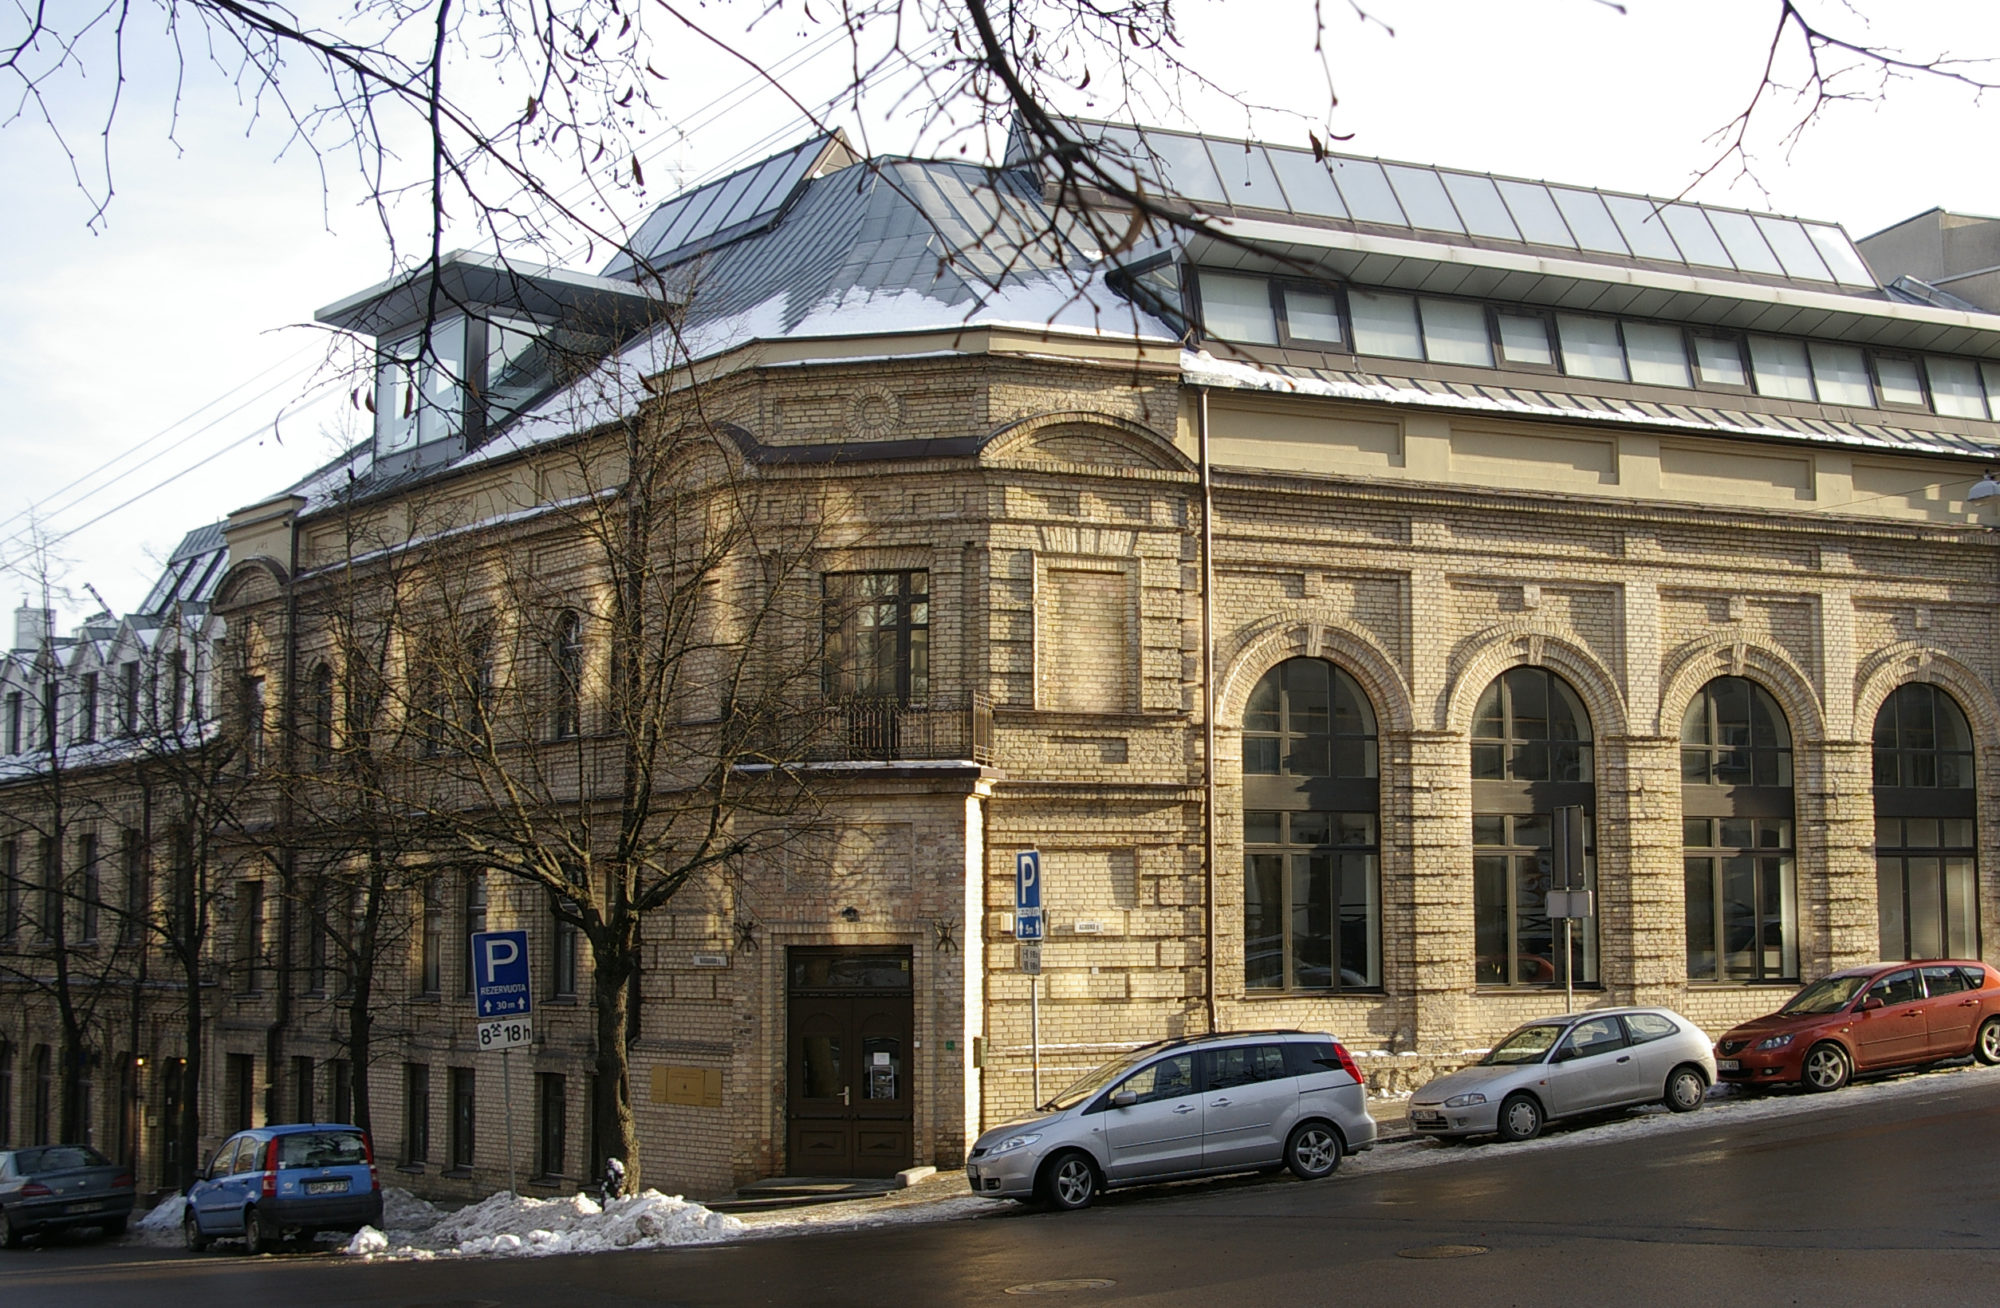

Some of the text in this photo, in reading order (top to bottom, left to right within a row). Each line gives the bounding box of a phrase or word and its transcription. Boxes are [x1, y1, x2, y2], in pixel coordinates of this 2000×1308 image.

[1020, 855, 1035, 905] P
[485, 938, 519, 983] P
[480, 983, 527, 996] REZERVUOTA
